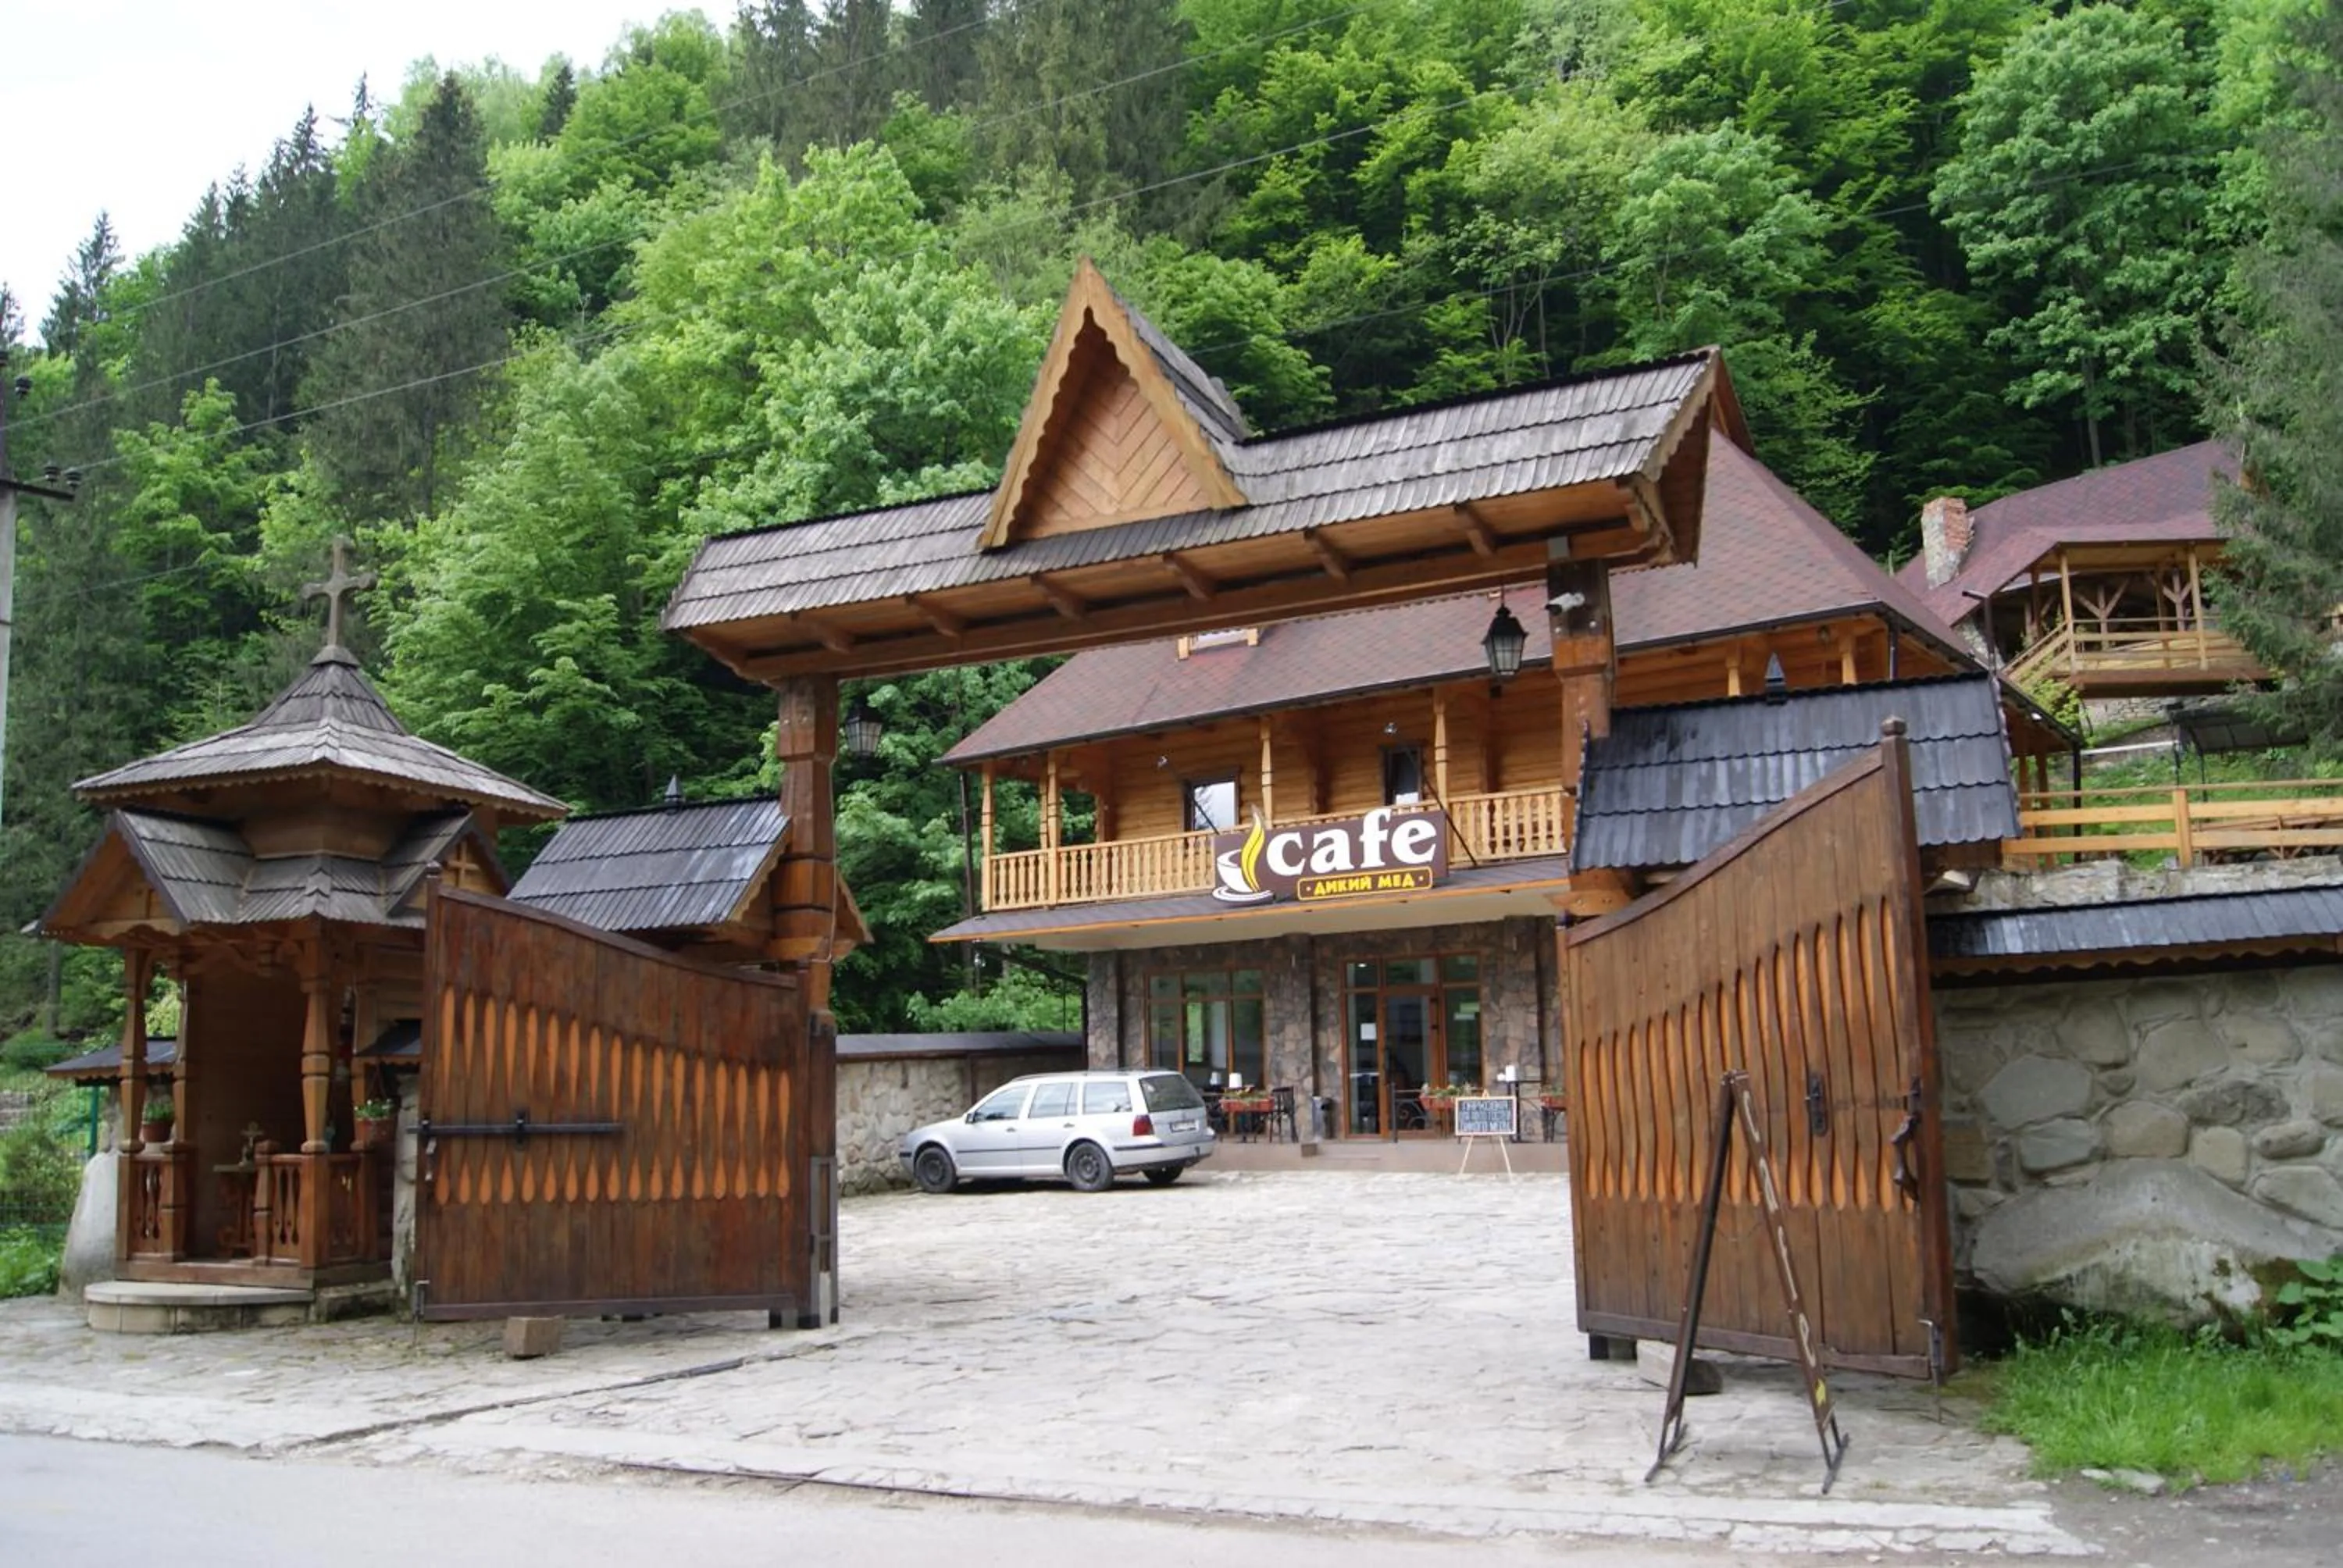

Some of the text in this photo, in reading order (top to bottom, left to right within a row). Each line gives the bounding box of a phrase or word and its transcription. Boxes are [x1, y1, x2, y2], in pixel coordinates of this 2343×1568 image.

[1266, 808, 1437, 875] cafe
[1314, 873, 1415, 896] ДИКИЙ МЕД
